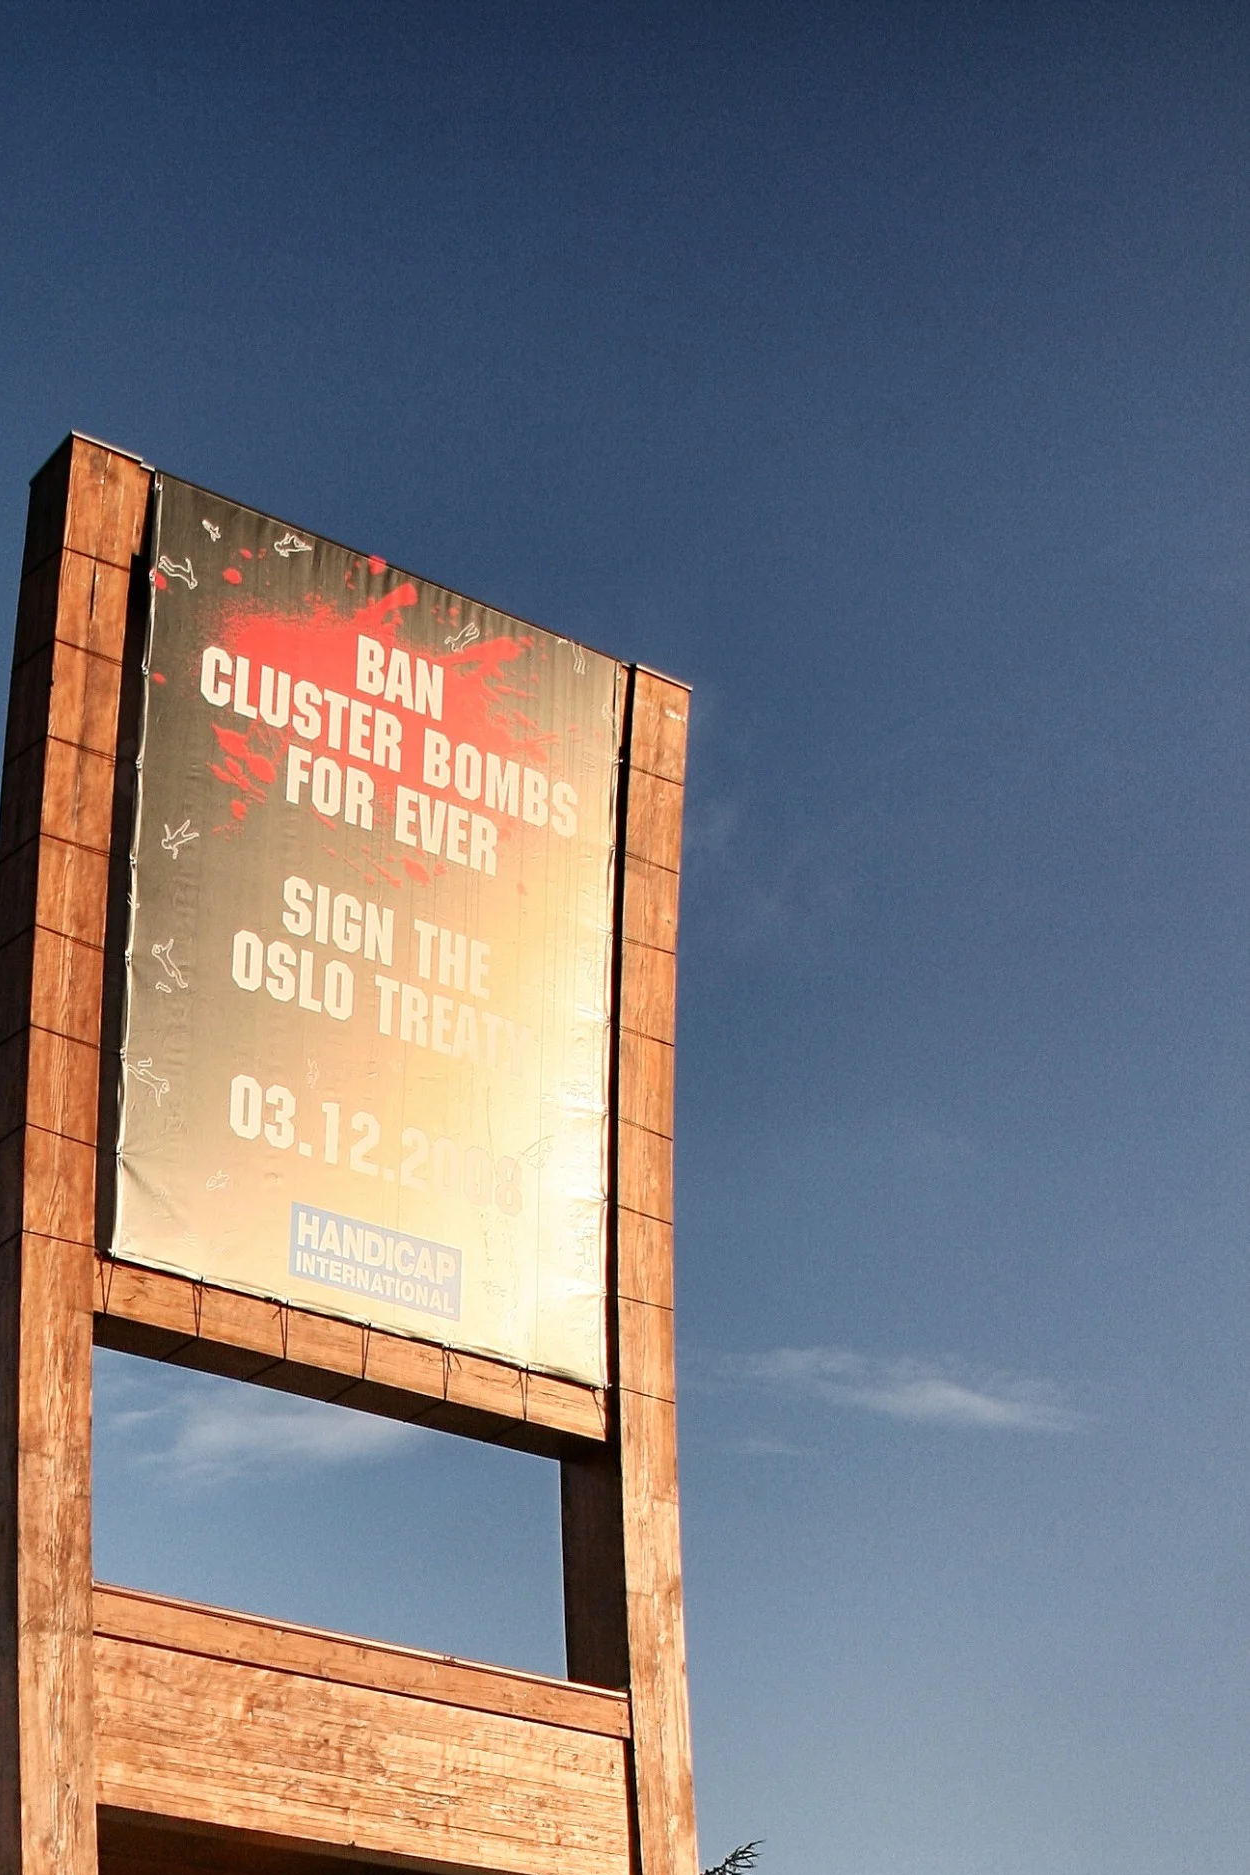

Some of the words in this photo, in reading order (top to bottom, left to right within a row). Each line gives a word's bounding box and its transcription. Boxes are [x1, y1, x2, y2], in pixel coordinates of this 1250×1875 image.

[356, 634, 445, 721] BAN
[200, 646, 403, 772] CLUSTER
[423, 727, 578, 838] BOMBS
[286, 744, 375, 831] FOR
[394, 785, 498, 876] EVER
[282, 875, 395, 967] SIGN
[414, 921, 491, 1000] THE
[231, 929, 355, 1022] OSLO
[374, 974, 533, 1078] TREATY
[229, 1073, 524, 1217] 03.12.2008
[295, 1250, 455, 1315] INTERNATIONAL
[296, 1211, 456, 1285] HANDICAP
